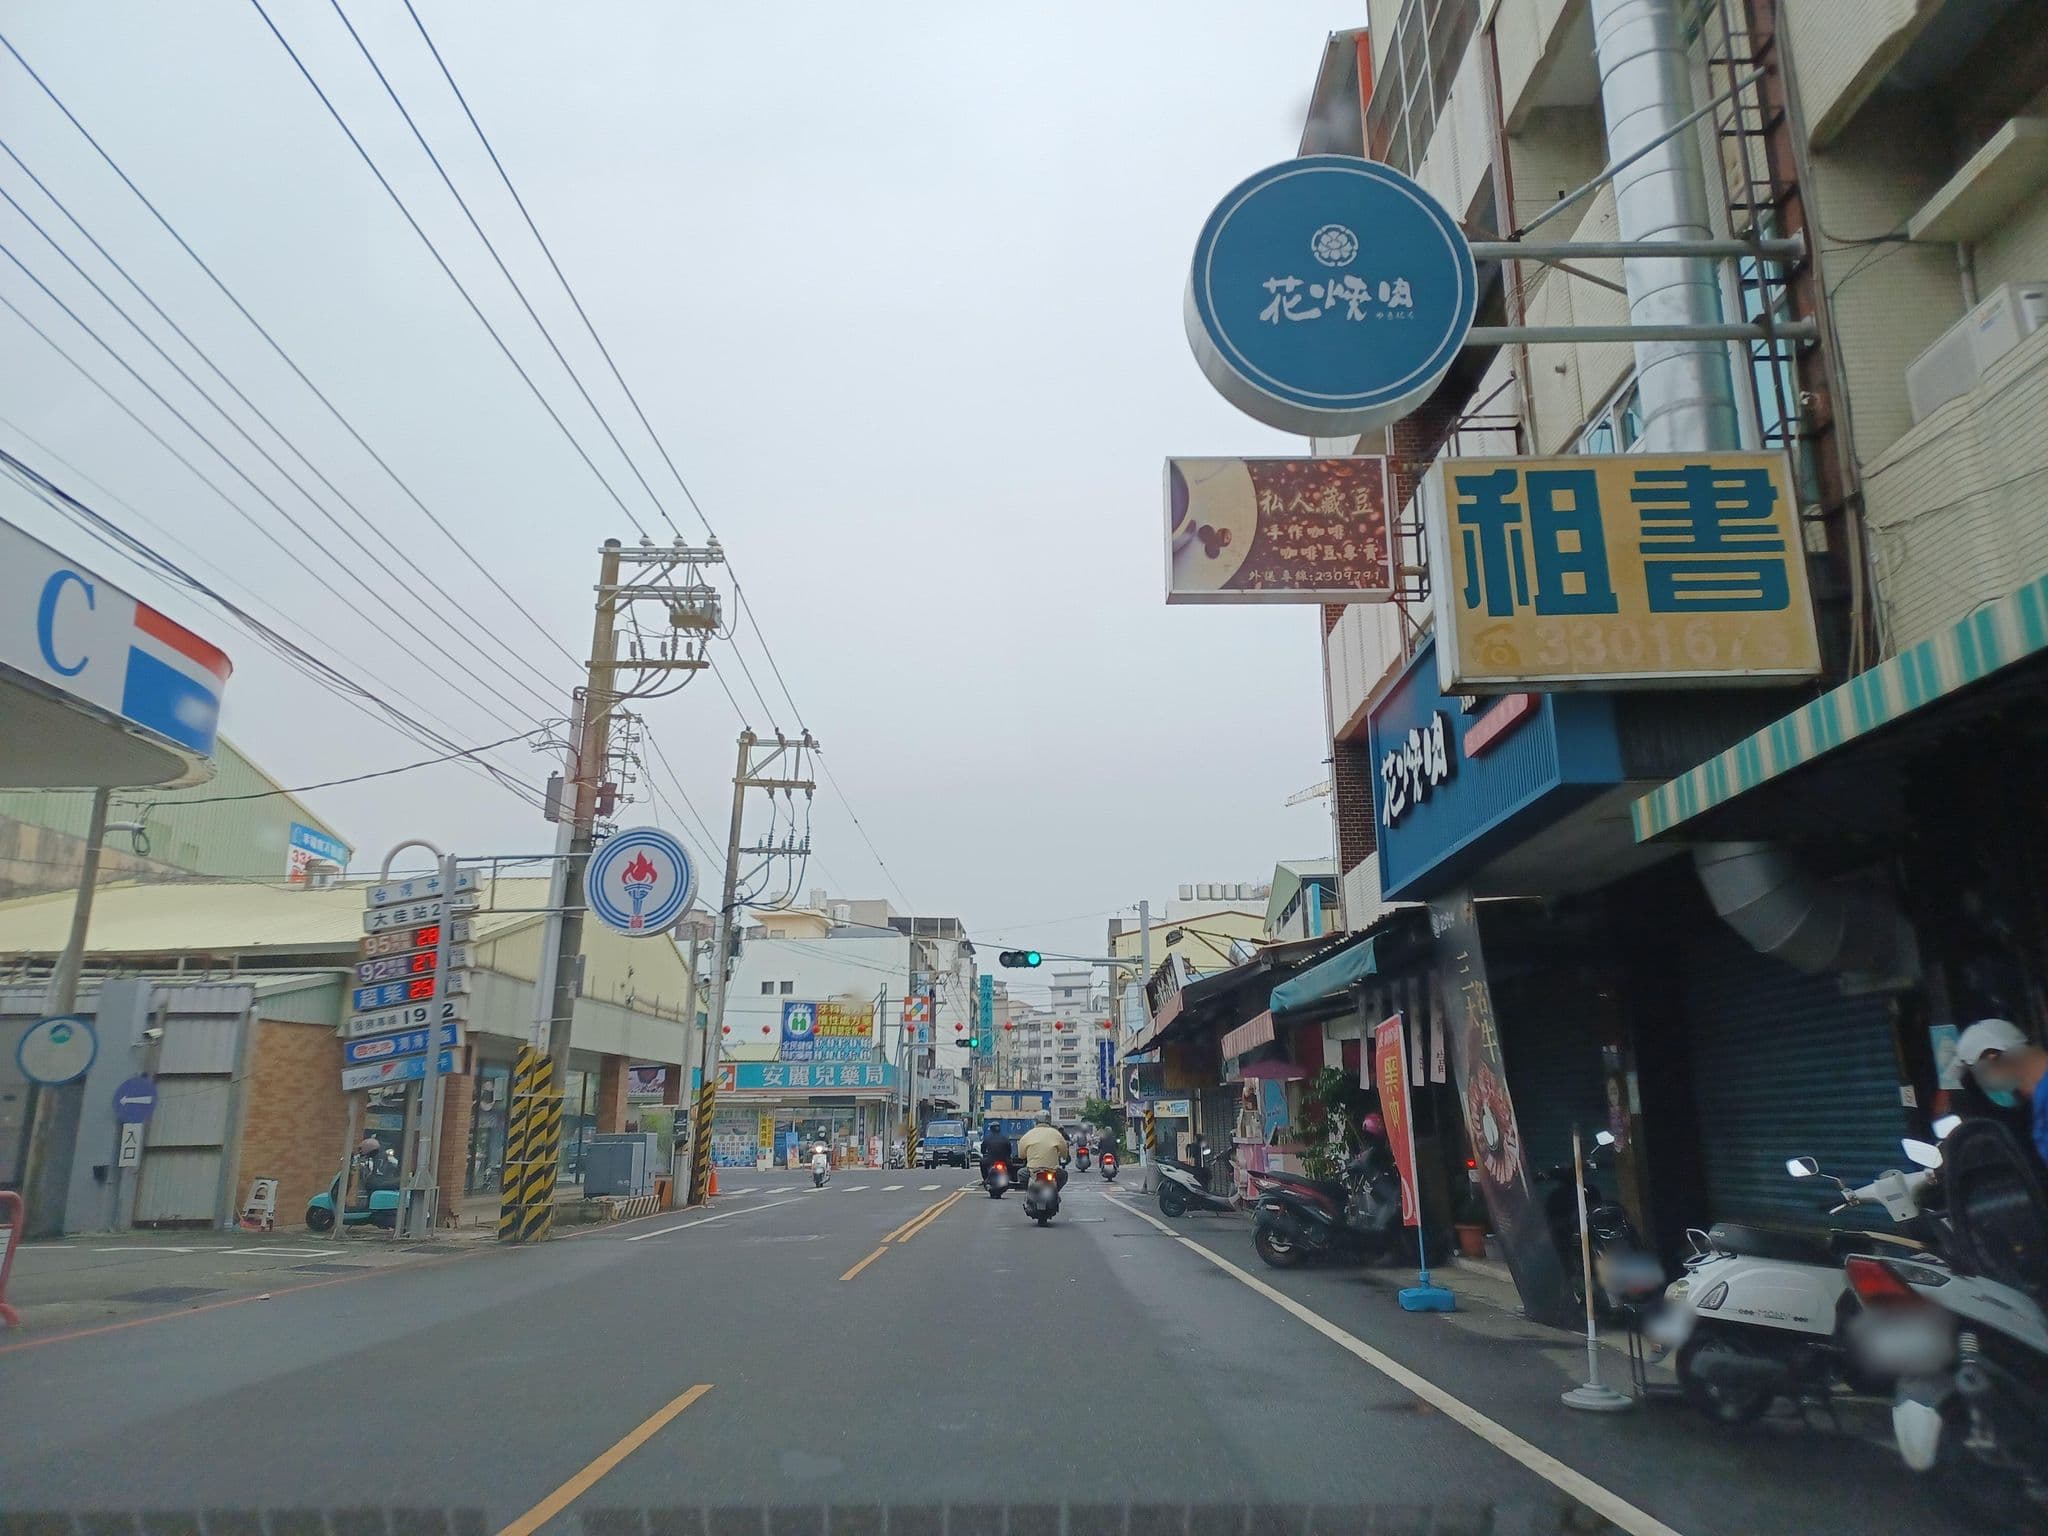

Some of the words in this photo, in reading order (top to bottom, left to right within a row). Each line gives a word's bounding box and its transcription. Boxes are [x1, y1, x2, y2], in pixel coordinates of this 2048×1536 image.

[1260, 487, 1374, 517] 私人藏豆
[1266, 525, 1345, 540] 手作咖啡
[1455, 465, 1790, 617] 租書
[37, 569, 95, 677] C
[365, 935, 390, 955] 95
[360, 962, 387, 982] 92
[359, 984, 404, 1008] 超柴
[762, 1066, 884, 1087] 安麗兒藥局
[124, 1131, 137, 1161] 入口
